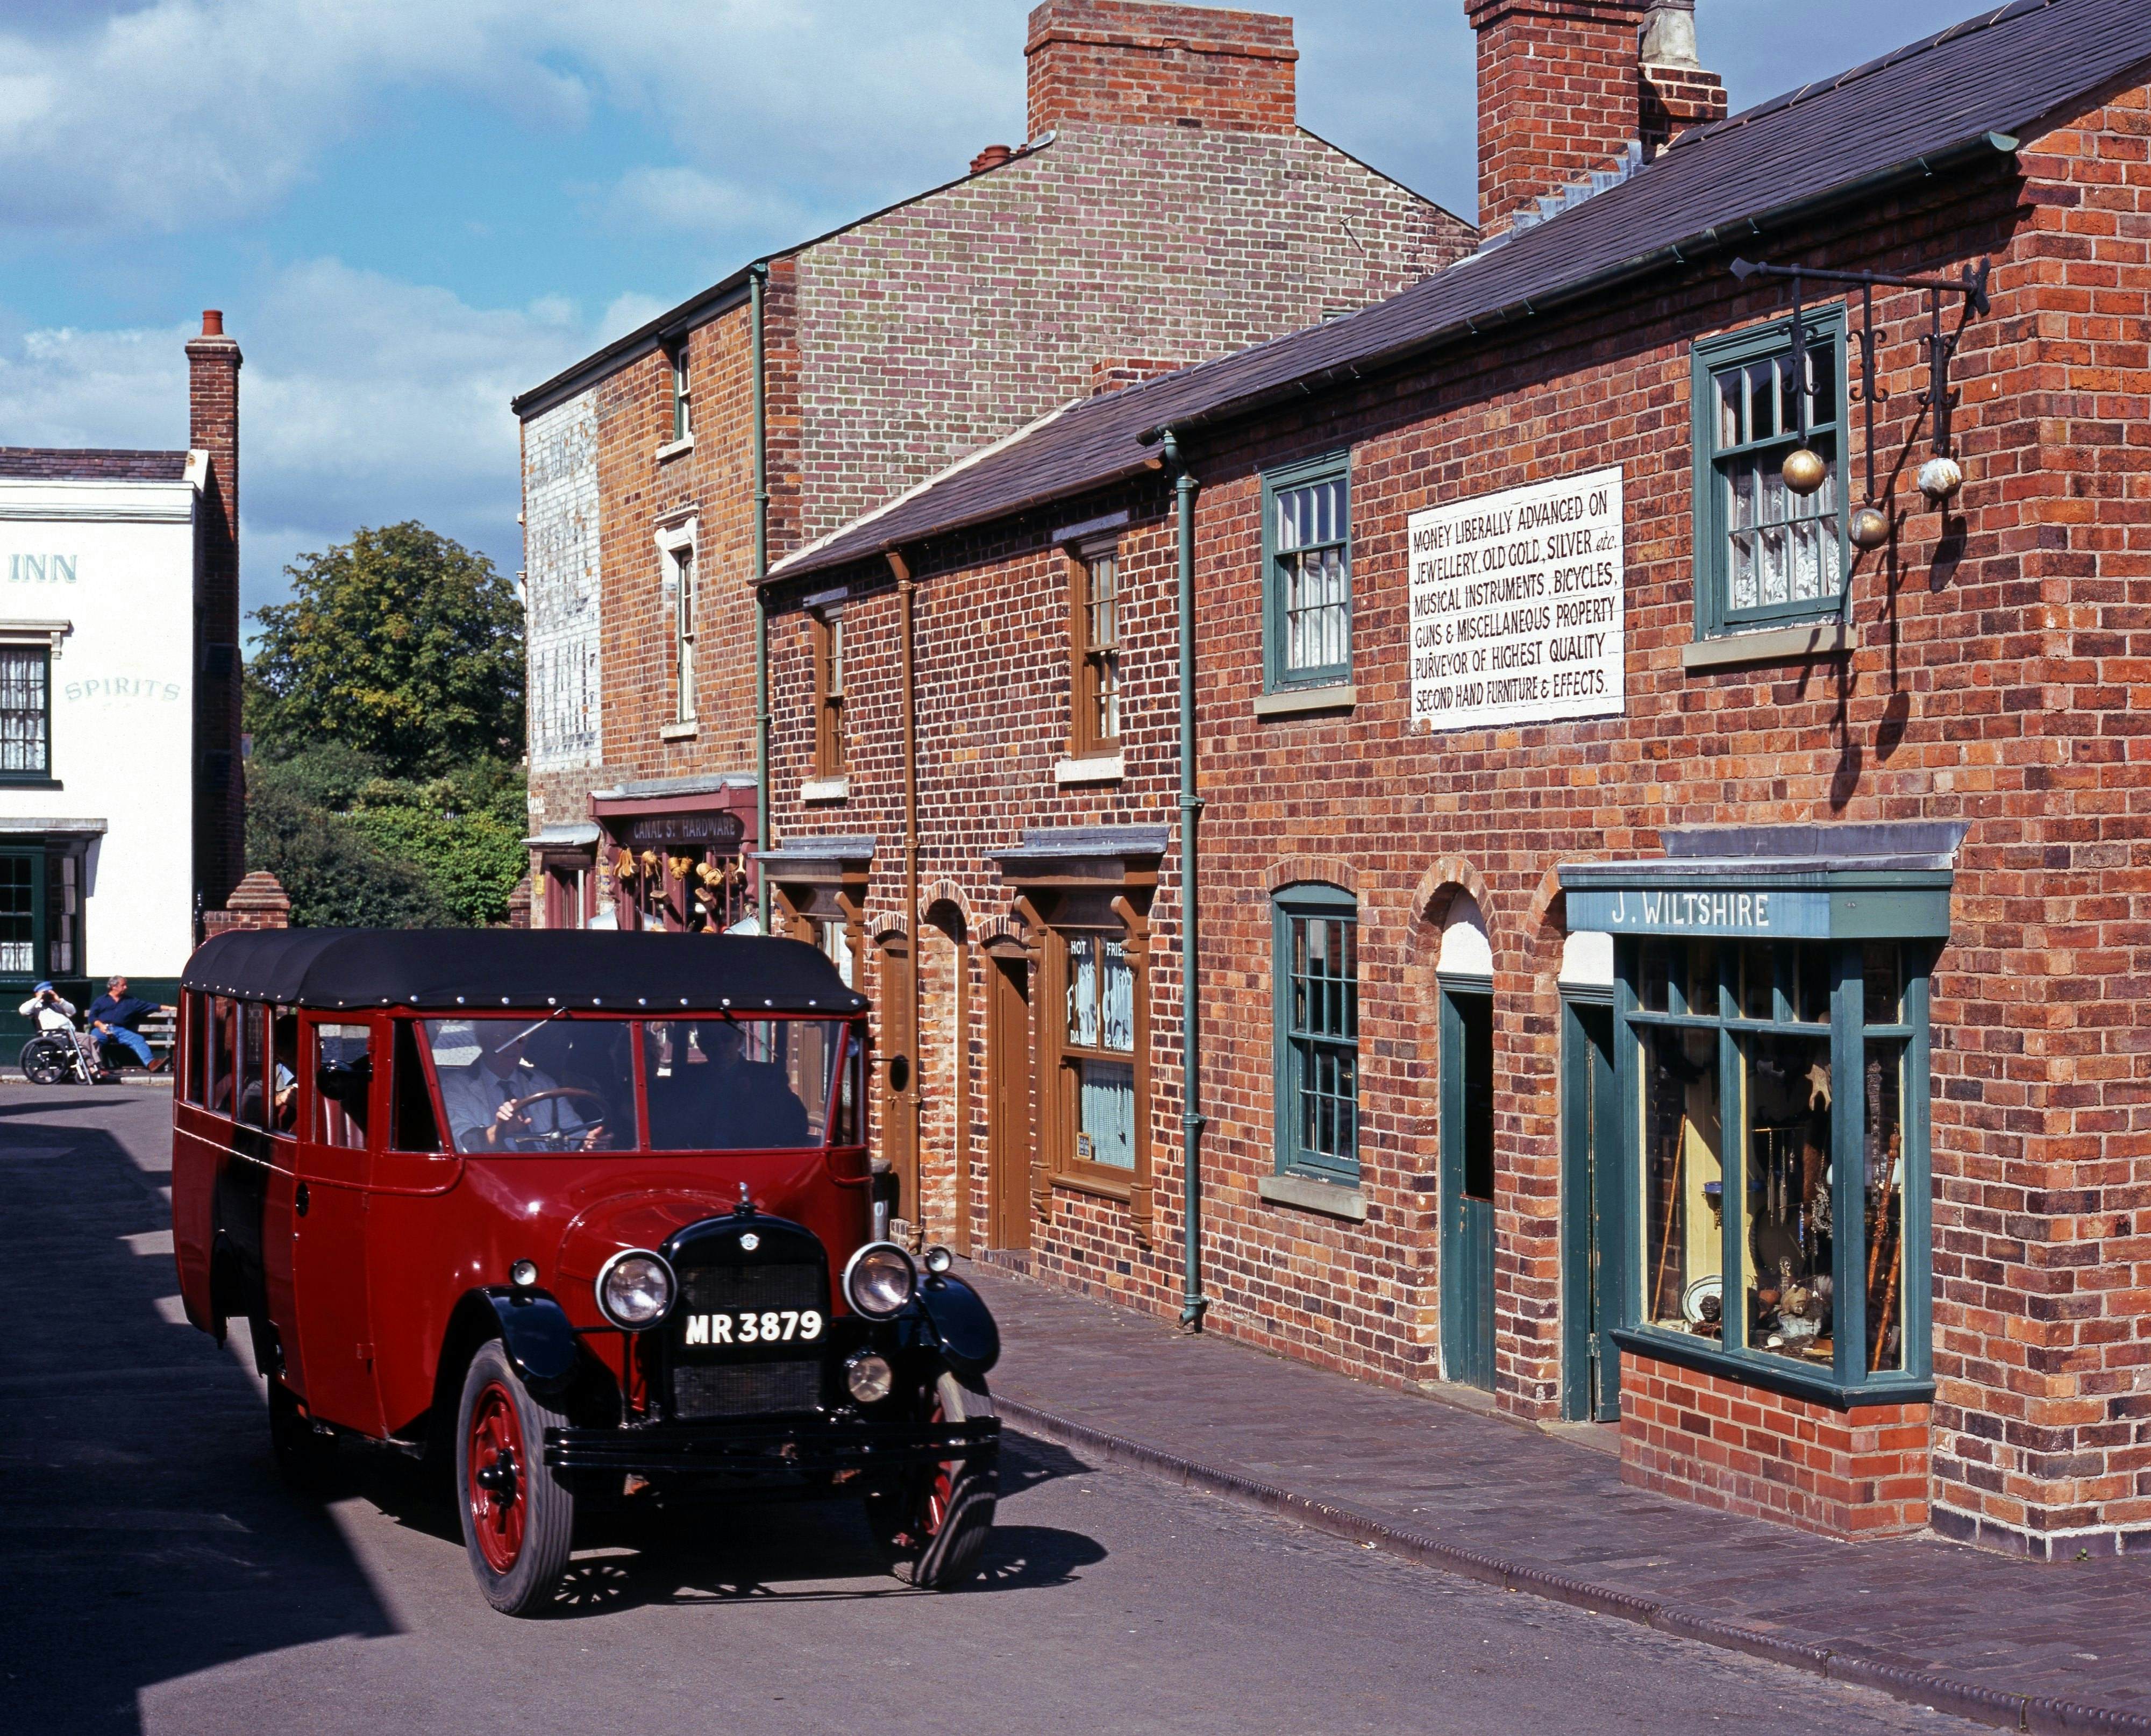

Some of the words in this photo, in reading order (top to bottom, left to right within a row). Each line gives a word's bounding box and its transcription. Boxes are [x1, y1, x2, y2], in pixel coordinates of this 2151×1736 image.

[1414, 524, 1452, 553] MONEY
[1456, 510, 1513, 544] LIBERALLY
[1517, 496, 1583, 531] ADVANCED
[1589, 490, 1607, 516] ON
[8, 553, 77, 583] INN
[1483, 545, 1506, 571] OLD
[1548, 529, 1592, 559] SILVER
[1596, 531, 1616, 551] etc.
[1414, 588, 1462, 617] MUSICAL
[1554, 561, 1617, 593] BICYCLES,
[1415, 624, 1443, 648] GUNS
[1446, 624, 1454, 644] &
[1457, 606, 1550, 642] MISCELLANEOUS
[1557, 596, 1615, 628] PROPERTY
[1416, 652, 1468, 680] PURVEYOR
[1472, 649, 1486, 671] OF
[1492, 641, 1542, 670] HIGHEST
[1550, 632, 1606, 662] QUALITY
[65, 675, 181, 702] SPIRITS
[1416, 686, 1453, 712] SECOND
[1456, 682, 1483, 707] HAND
[1487, 676, 1537, 704] FURNITURE
[1541, 679, 1549, 698] &
[1554, 669, 1608, 698] EFFECTS.
[634, 820, 662, 839] CANAL
[682, 817, 735, 838] HARDWARE
[1612, 891, 1635, 923] J.
[1642, 891, 1769, 926] WILTSHIRE
[1071, 941, 1086, 955] HOT
[1106, 942, 1127, 956] FRIE
[686, 1314, 733, 1344] MR
[738, 1310, 822, 1342] 3879
